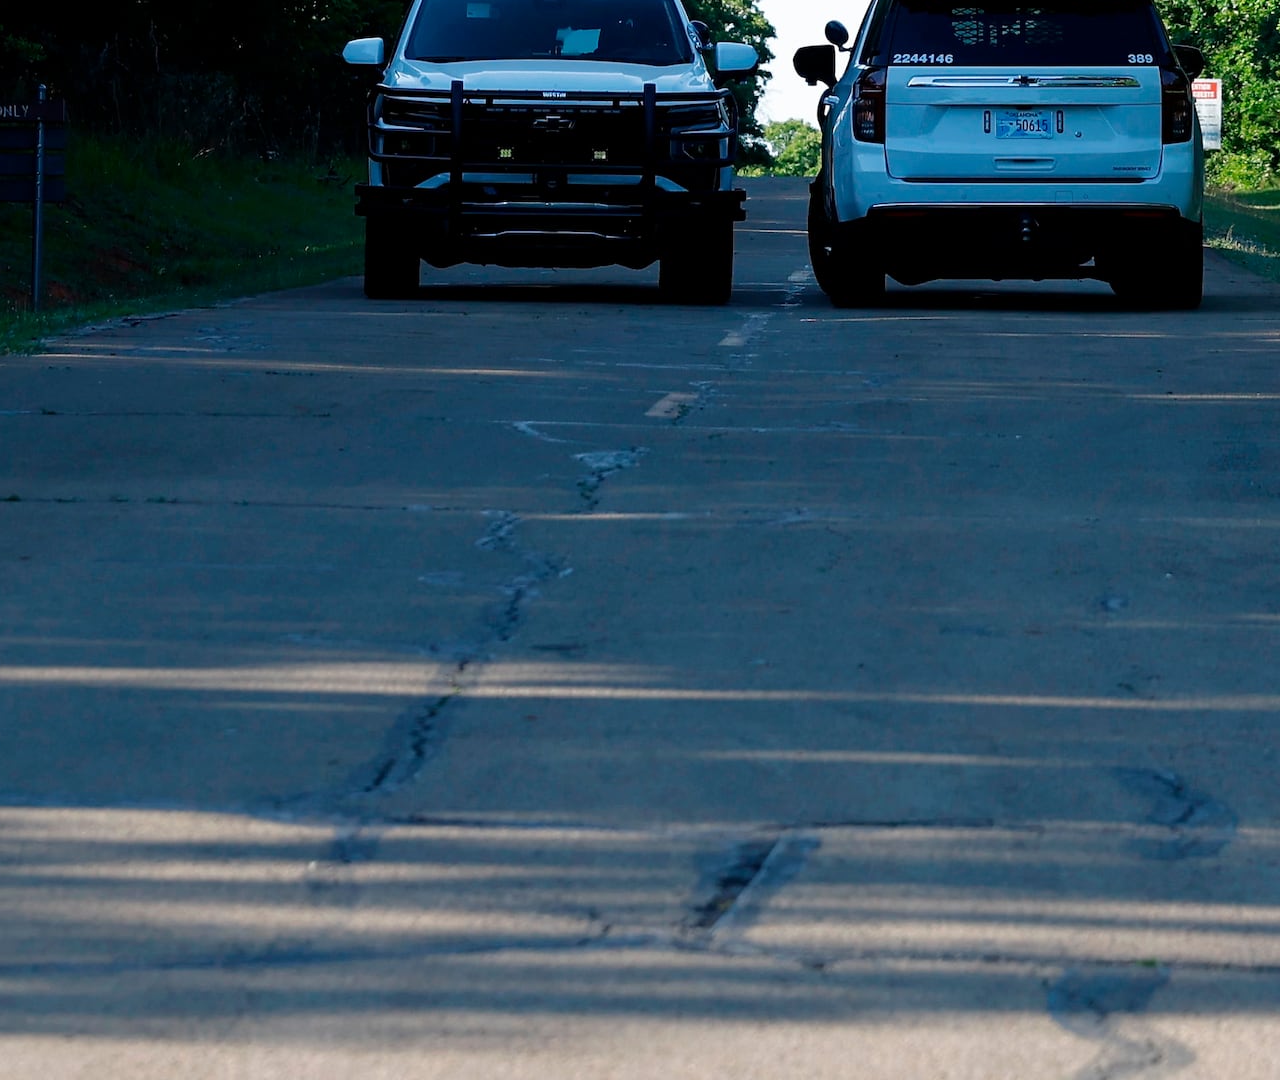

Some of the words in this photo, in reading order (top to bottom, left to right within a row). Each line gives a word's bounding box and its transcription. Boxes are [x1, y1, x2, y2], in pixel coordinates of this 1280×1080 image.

[893, 53, 954, 64] 2244146
[1127, 53, 1154, 64] 389
[1016, 119, 1048, 132] 50615
